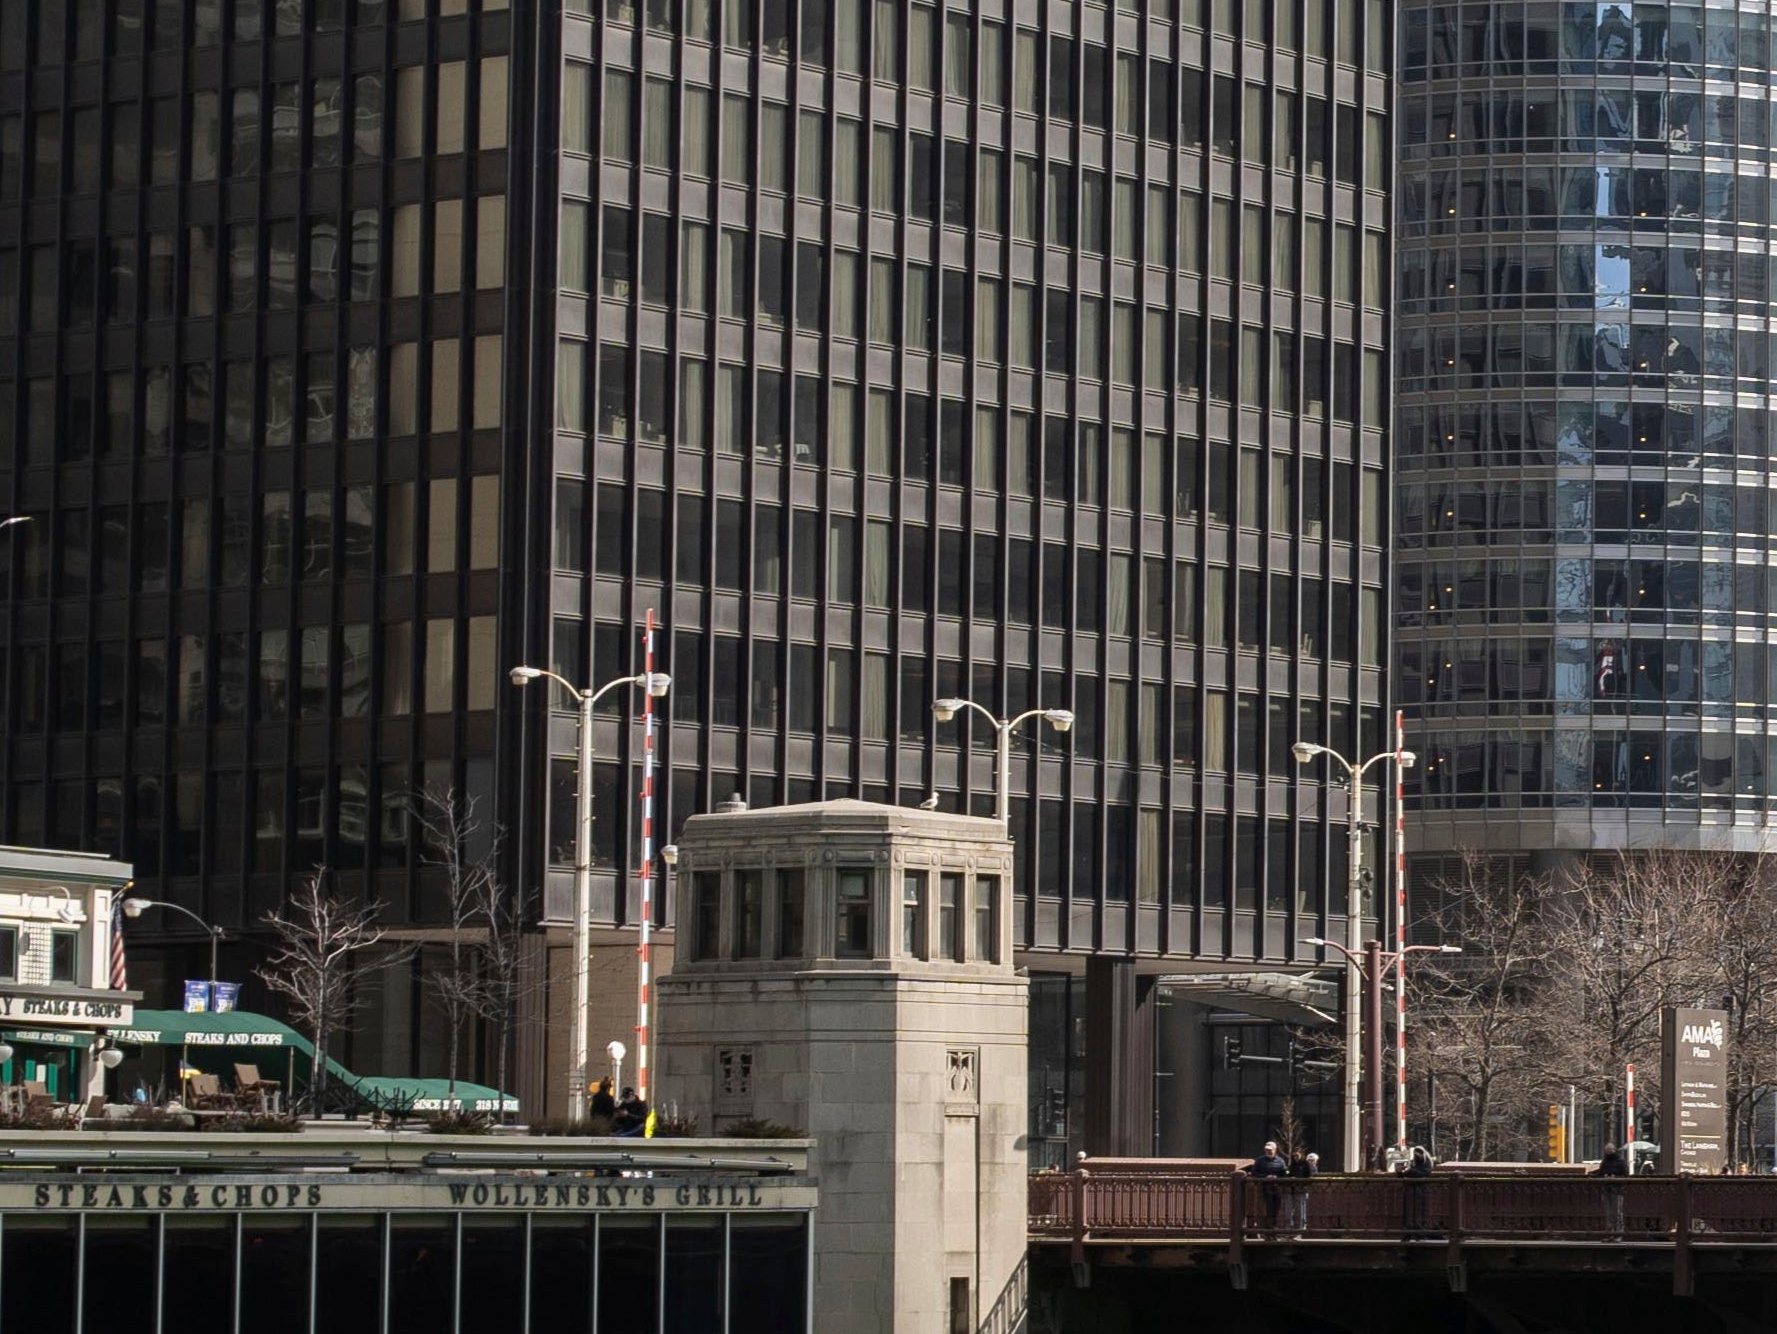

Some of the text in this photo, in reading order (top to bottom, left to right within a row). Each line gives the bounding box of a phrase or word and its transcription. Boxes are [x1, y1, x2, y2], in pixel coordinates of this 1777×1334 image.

[23, 998, 69, 1016] STEAKS
[72, 1002, 81, 1016] &
[84, 1003, 122, 1018] CHOPS
[184, 1032, 283, 1045] STEAKS AND CHOPS
[1681, 1025, 1713, 1044] AMA
[450, 1183, 763, 1207] WOLLENSKY'S GRILL
